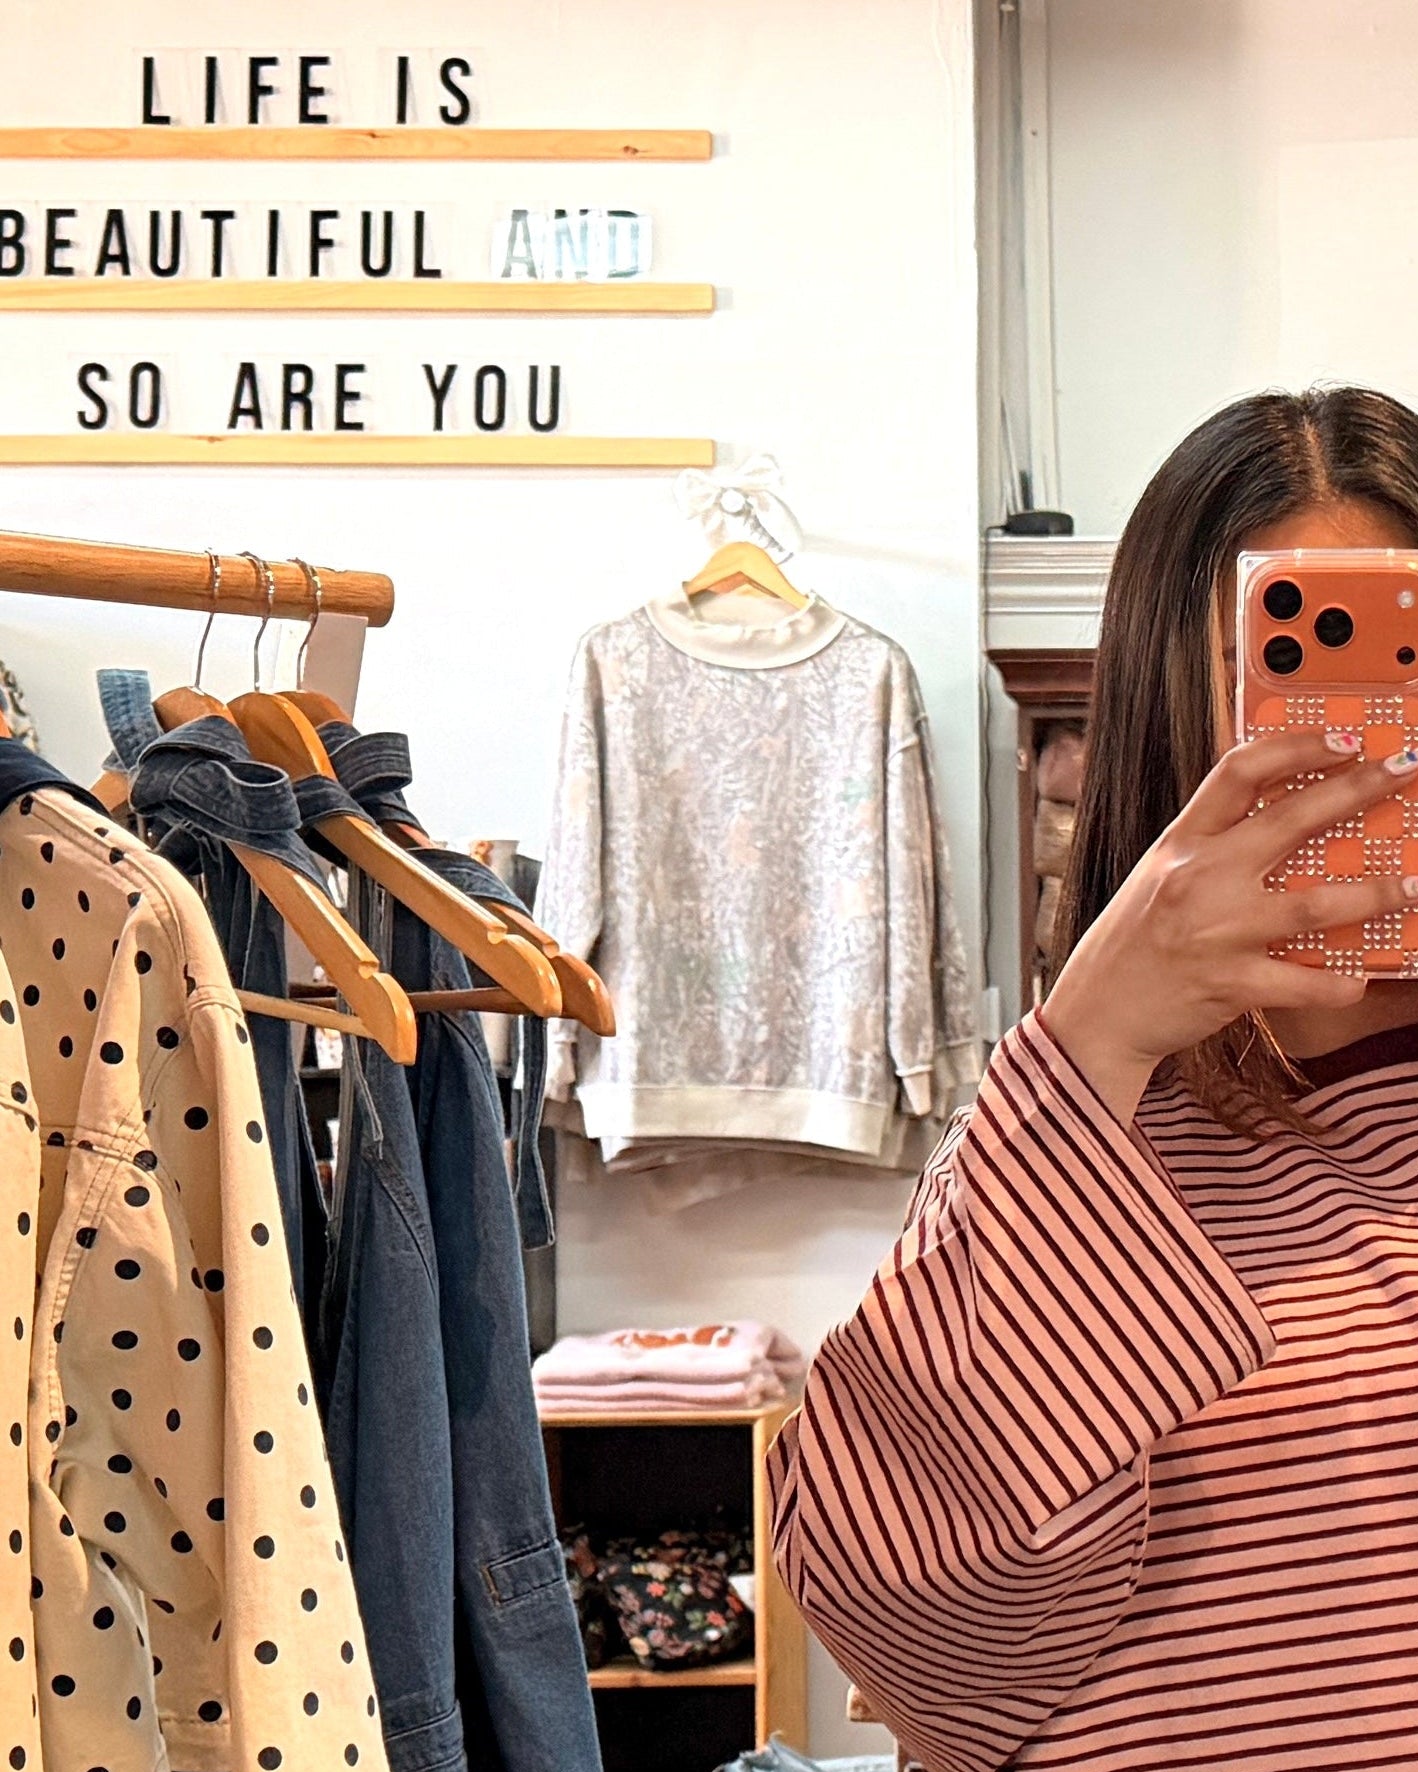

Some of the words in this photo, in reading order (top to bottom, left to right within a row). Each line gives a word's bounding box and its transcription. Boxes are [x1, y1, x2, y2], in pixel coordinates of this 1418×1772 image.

[142, 56, 331, 125] LIFE
[396, 56, 472, 126] IS
[0, 208, 442, 278] BEAUTIFUL
[500, 208, 641, 280] AND
[76, 361, 162, 431] SO
[227, 362, 366, 432] ARE
[422, 364, 562, 433] YOU
